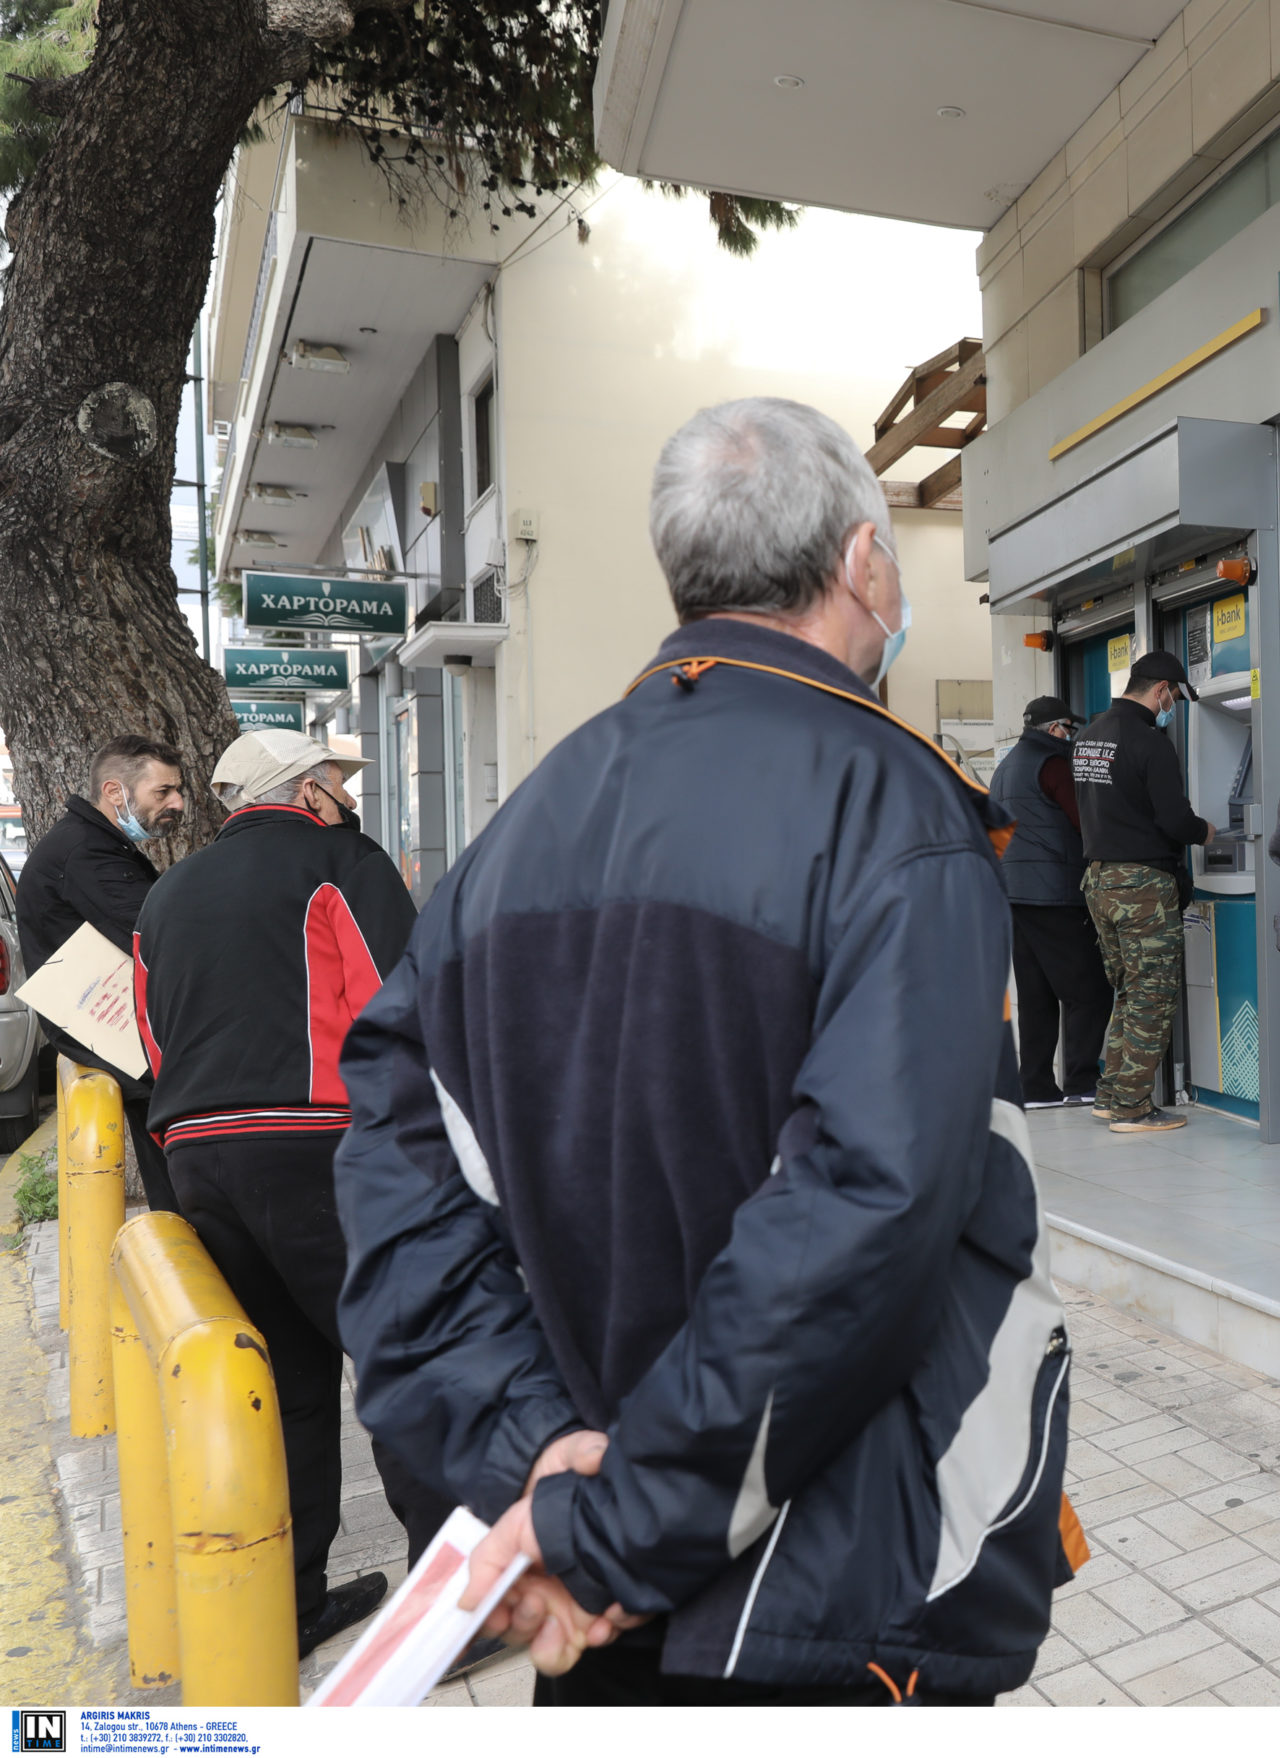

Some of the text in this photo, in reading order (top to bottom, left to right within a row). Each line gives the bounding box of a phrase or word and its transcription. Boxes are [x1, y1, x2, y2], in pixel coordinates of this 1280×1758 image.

[261, 594, 394, 616] ΧΑΡΤΟΡΑΜΑ
[1216, 604, 1241, 627] i-bank
[1110, 641, 1129, 660] i-bank
[235, 662, 338, 677] ΧΑΡΤΟΡΑΜΑ
